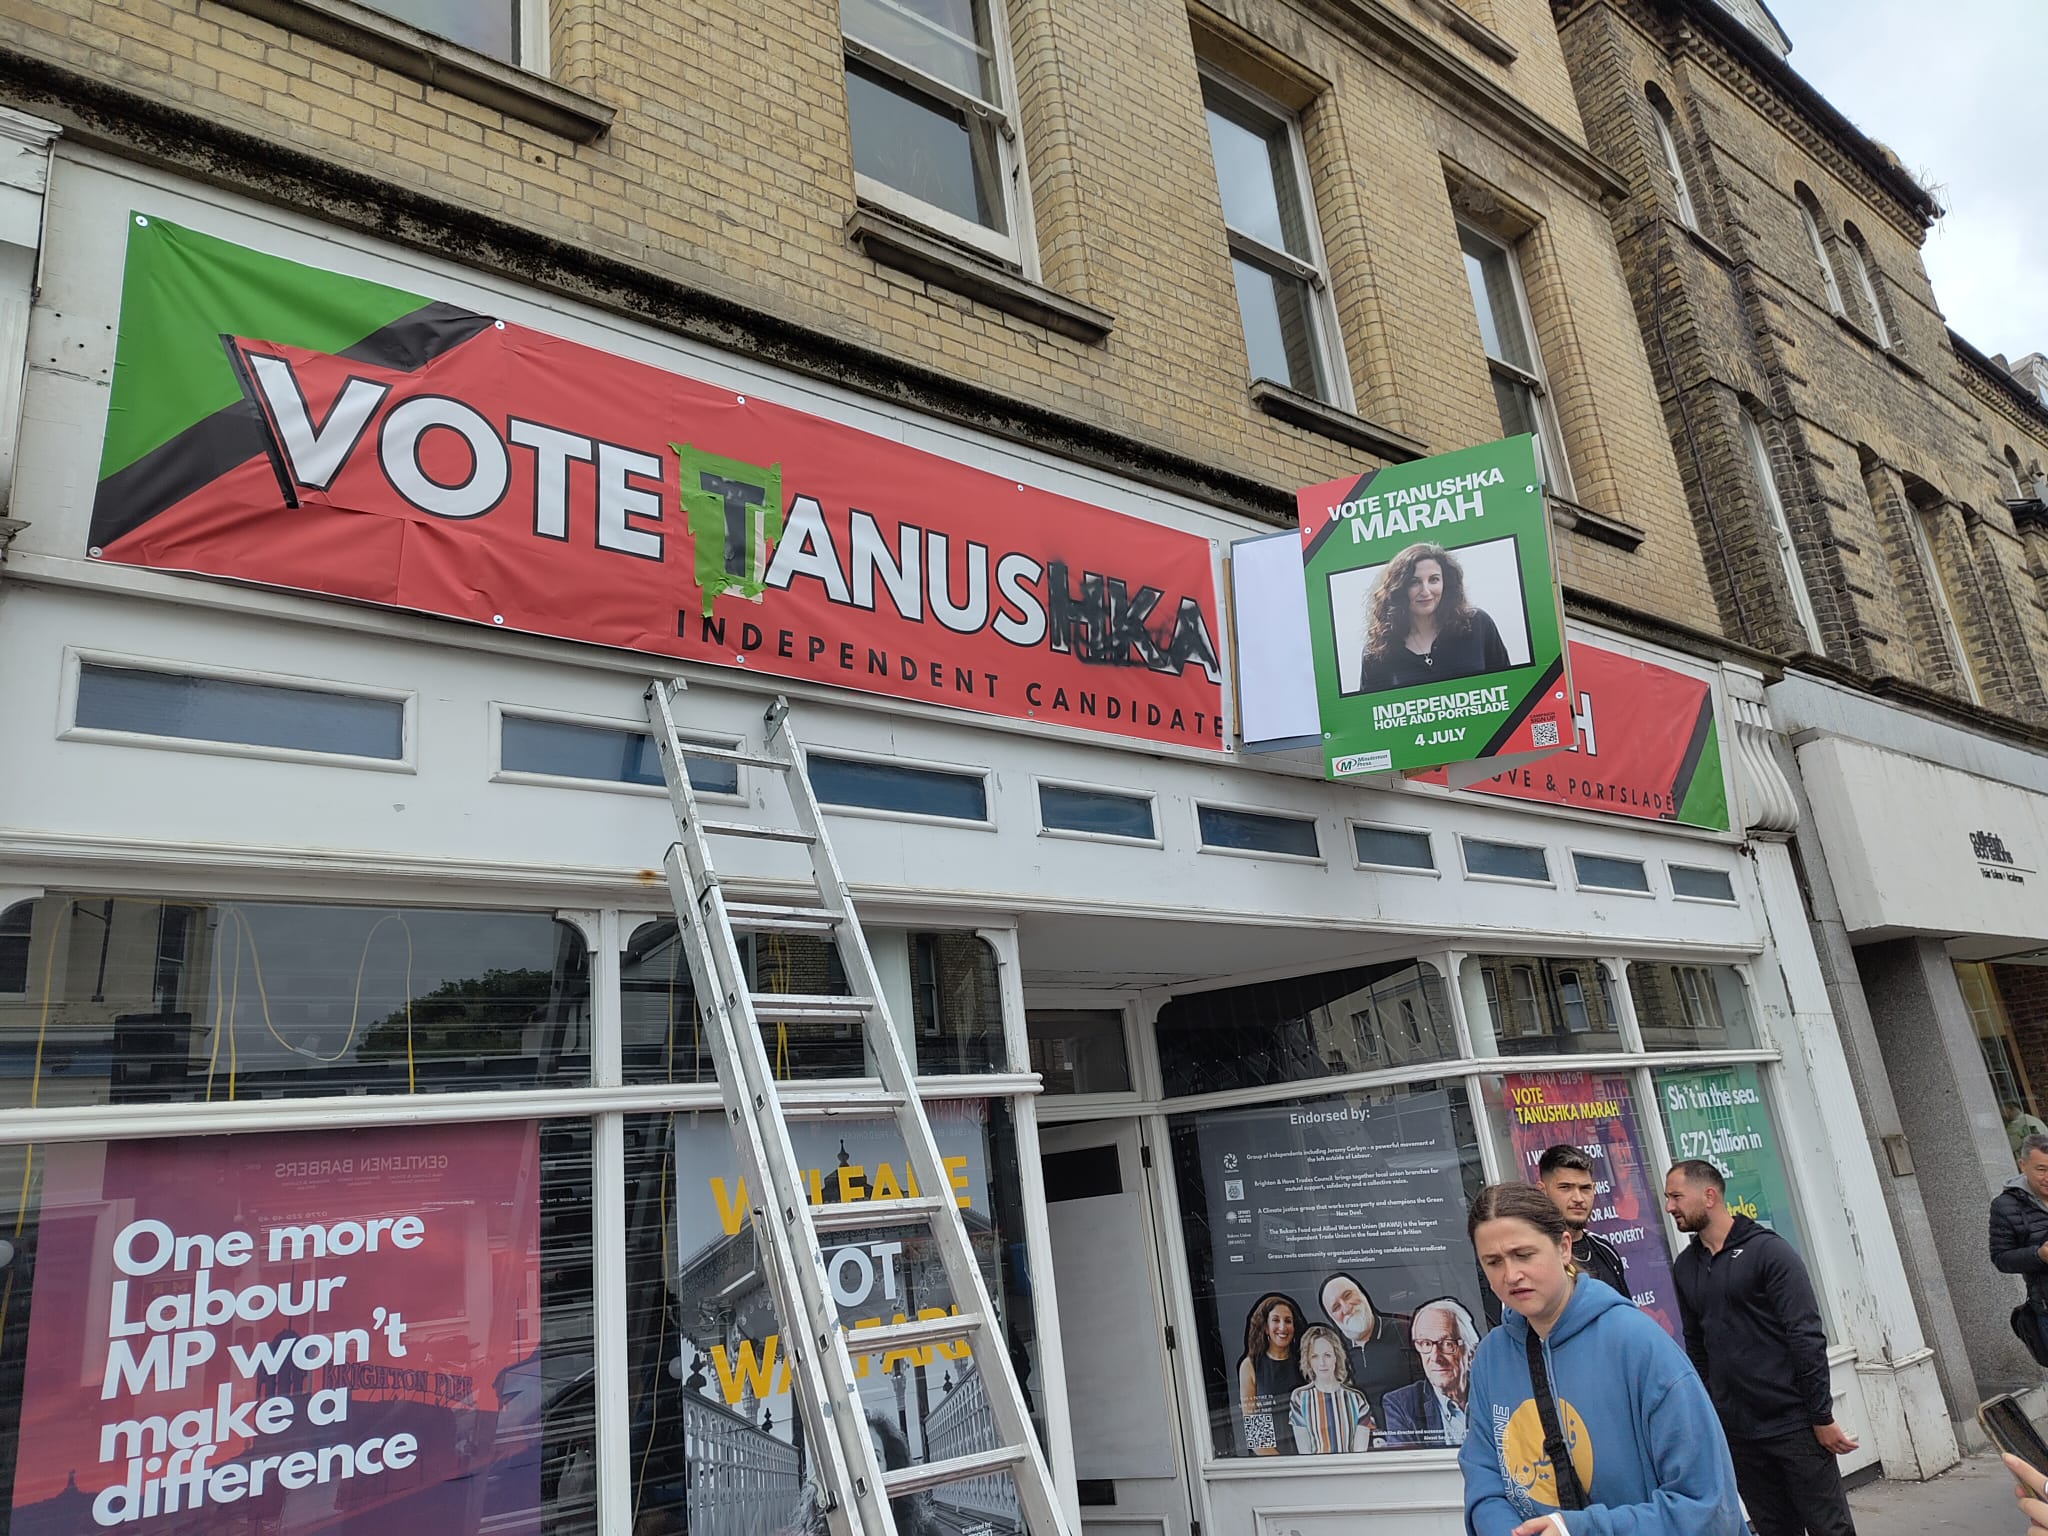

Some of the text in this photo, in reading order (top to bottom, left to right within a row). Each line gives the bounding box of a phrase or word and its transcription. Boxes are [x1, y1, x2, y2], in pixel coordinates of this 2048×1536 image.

[240, 350, 664, 562] VOTE
[1327, 467, 1505, 522] VOTE TANUSHKA
[1350, 490, 1485, 544] MARAH
[677, 609, 1224, 738] INDEPENDENT CANDIDATE
[1372, 685, 1508, 721] INDEPENDENT
[1374, 700, 1510, 731] HOVE AND PORTSLADE
[1414, 727, 1467, 747] 4 JULY
[1546, 774, 1556, 791] &
[1568, 778, 1673, 811] PORTSLADE
[1511, 1087, 1544, 1106] VOTE
[1695, 1084, 1711, 1108] in
[1709, 1082, 1732, 1107] the
[1732, 1087, 1760, 1104] sea.
[1290, 1107, 1371, 1125] Endorsed by:
[1515, 1100, 1620, 1125] TANUSHKA MARAH
[1246, 1153, 1262, 1161] Group
[1327, 1147, 1346, 1155] Jeremy
[1346, 1144, 1366, 1153] Corbyn
[1375, 1141, 1400, 1151] powerful
[1526, 1151, 1532, 1166] I
[1584, 1144, 1604, 1158] FOR
[1680, 1125, 1763, 1158] £72 billion in
[1352, 1172, 1375, 1181] together
[1603, 1205, 1619, 1219] ALL
[112, 1215, 425, 1277] One more
[1610, 1227, 1645, 1246] POVERTY
[827, 1242, 902, 1307] OT
[107, 1268, 347, 1339] Labour
[101, 1304, 408, 1401] MP won't
[434, 1371, 473, 1400] PIER
[98, 1382, 349, 1464] make a
[91, 1431, 418, 1527] difference
